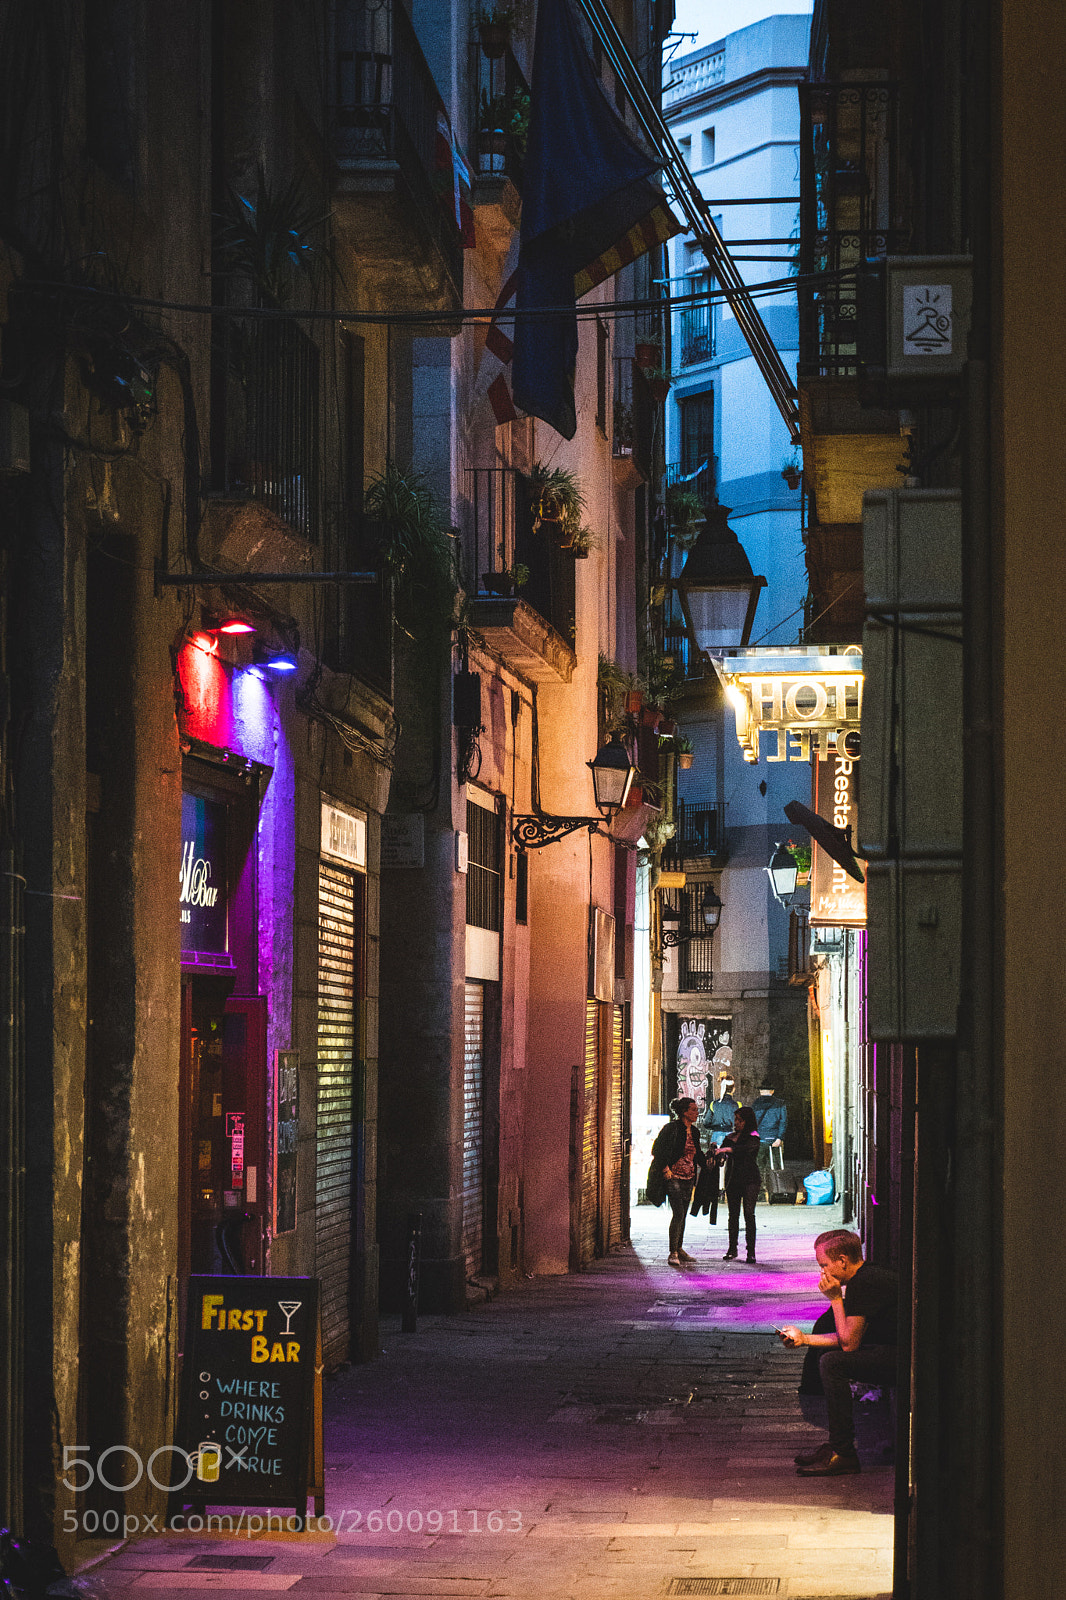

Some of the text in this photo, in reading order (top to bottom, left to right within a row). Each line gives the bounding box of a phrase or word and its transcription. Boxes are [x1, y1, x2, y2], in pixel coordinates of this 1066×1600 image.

[751, 682, 862, 721] HOT
[832, 756, 853, 894] Restant
[191, 858, 218, 907] Bar
[216, 1378, 281, 1399] WHERE
[220, 1401, 285, 1424] DRINKS
[225, 1425, 278, 1455] COME
[234, 1456, 282, 1476] TRUE
